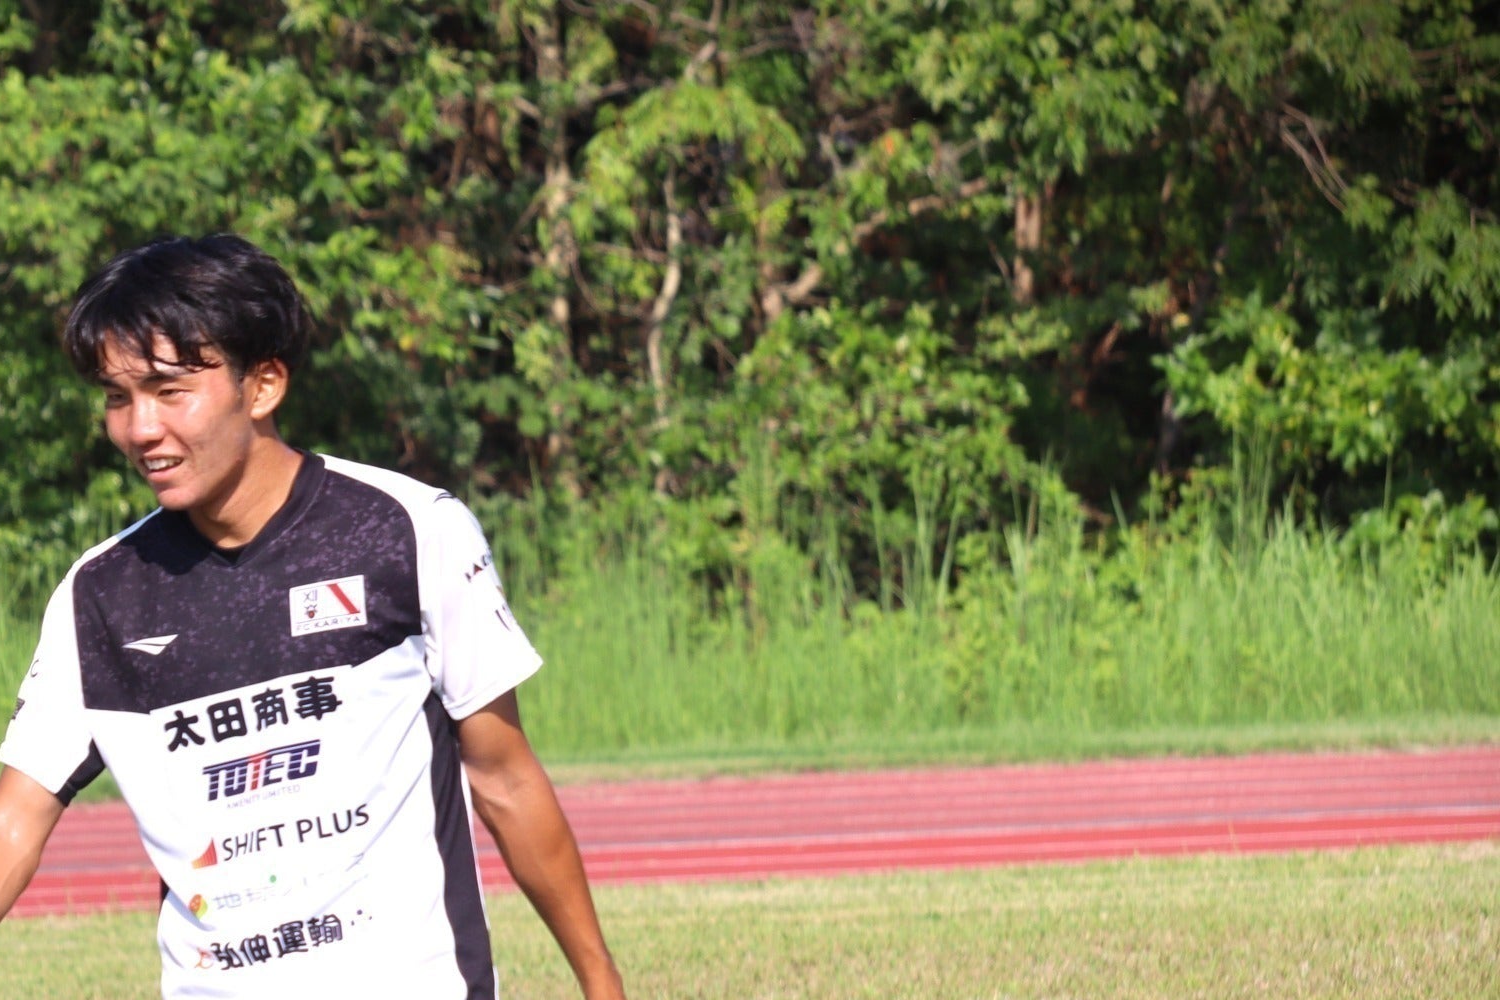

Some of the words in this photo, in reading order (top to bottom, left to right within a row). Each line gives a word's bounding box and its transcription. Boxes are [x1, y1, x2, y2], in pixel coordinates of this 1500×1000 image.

[164, 676, 343, 752] 太田商事
[222, 823, 285, 862] SHIFT
[296, 803, 370, 843] PLUS
[210, 914, 343, 971] 弘伸運輸
